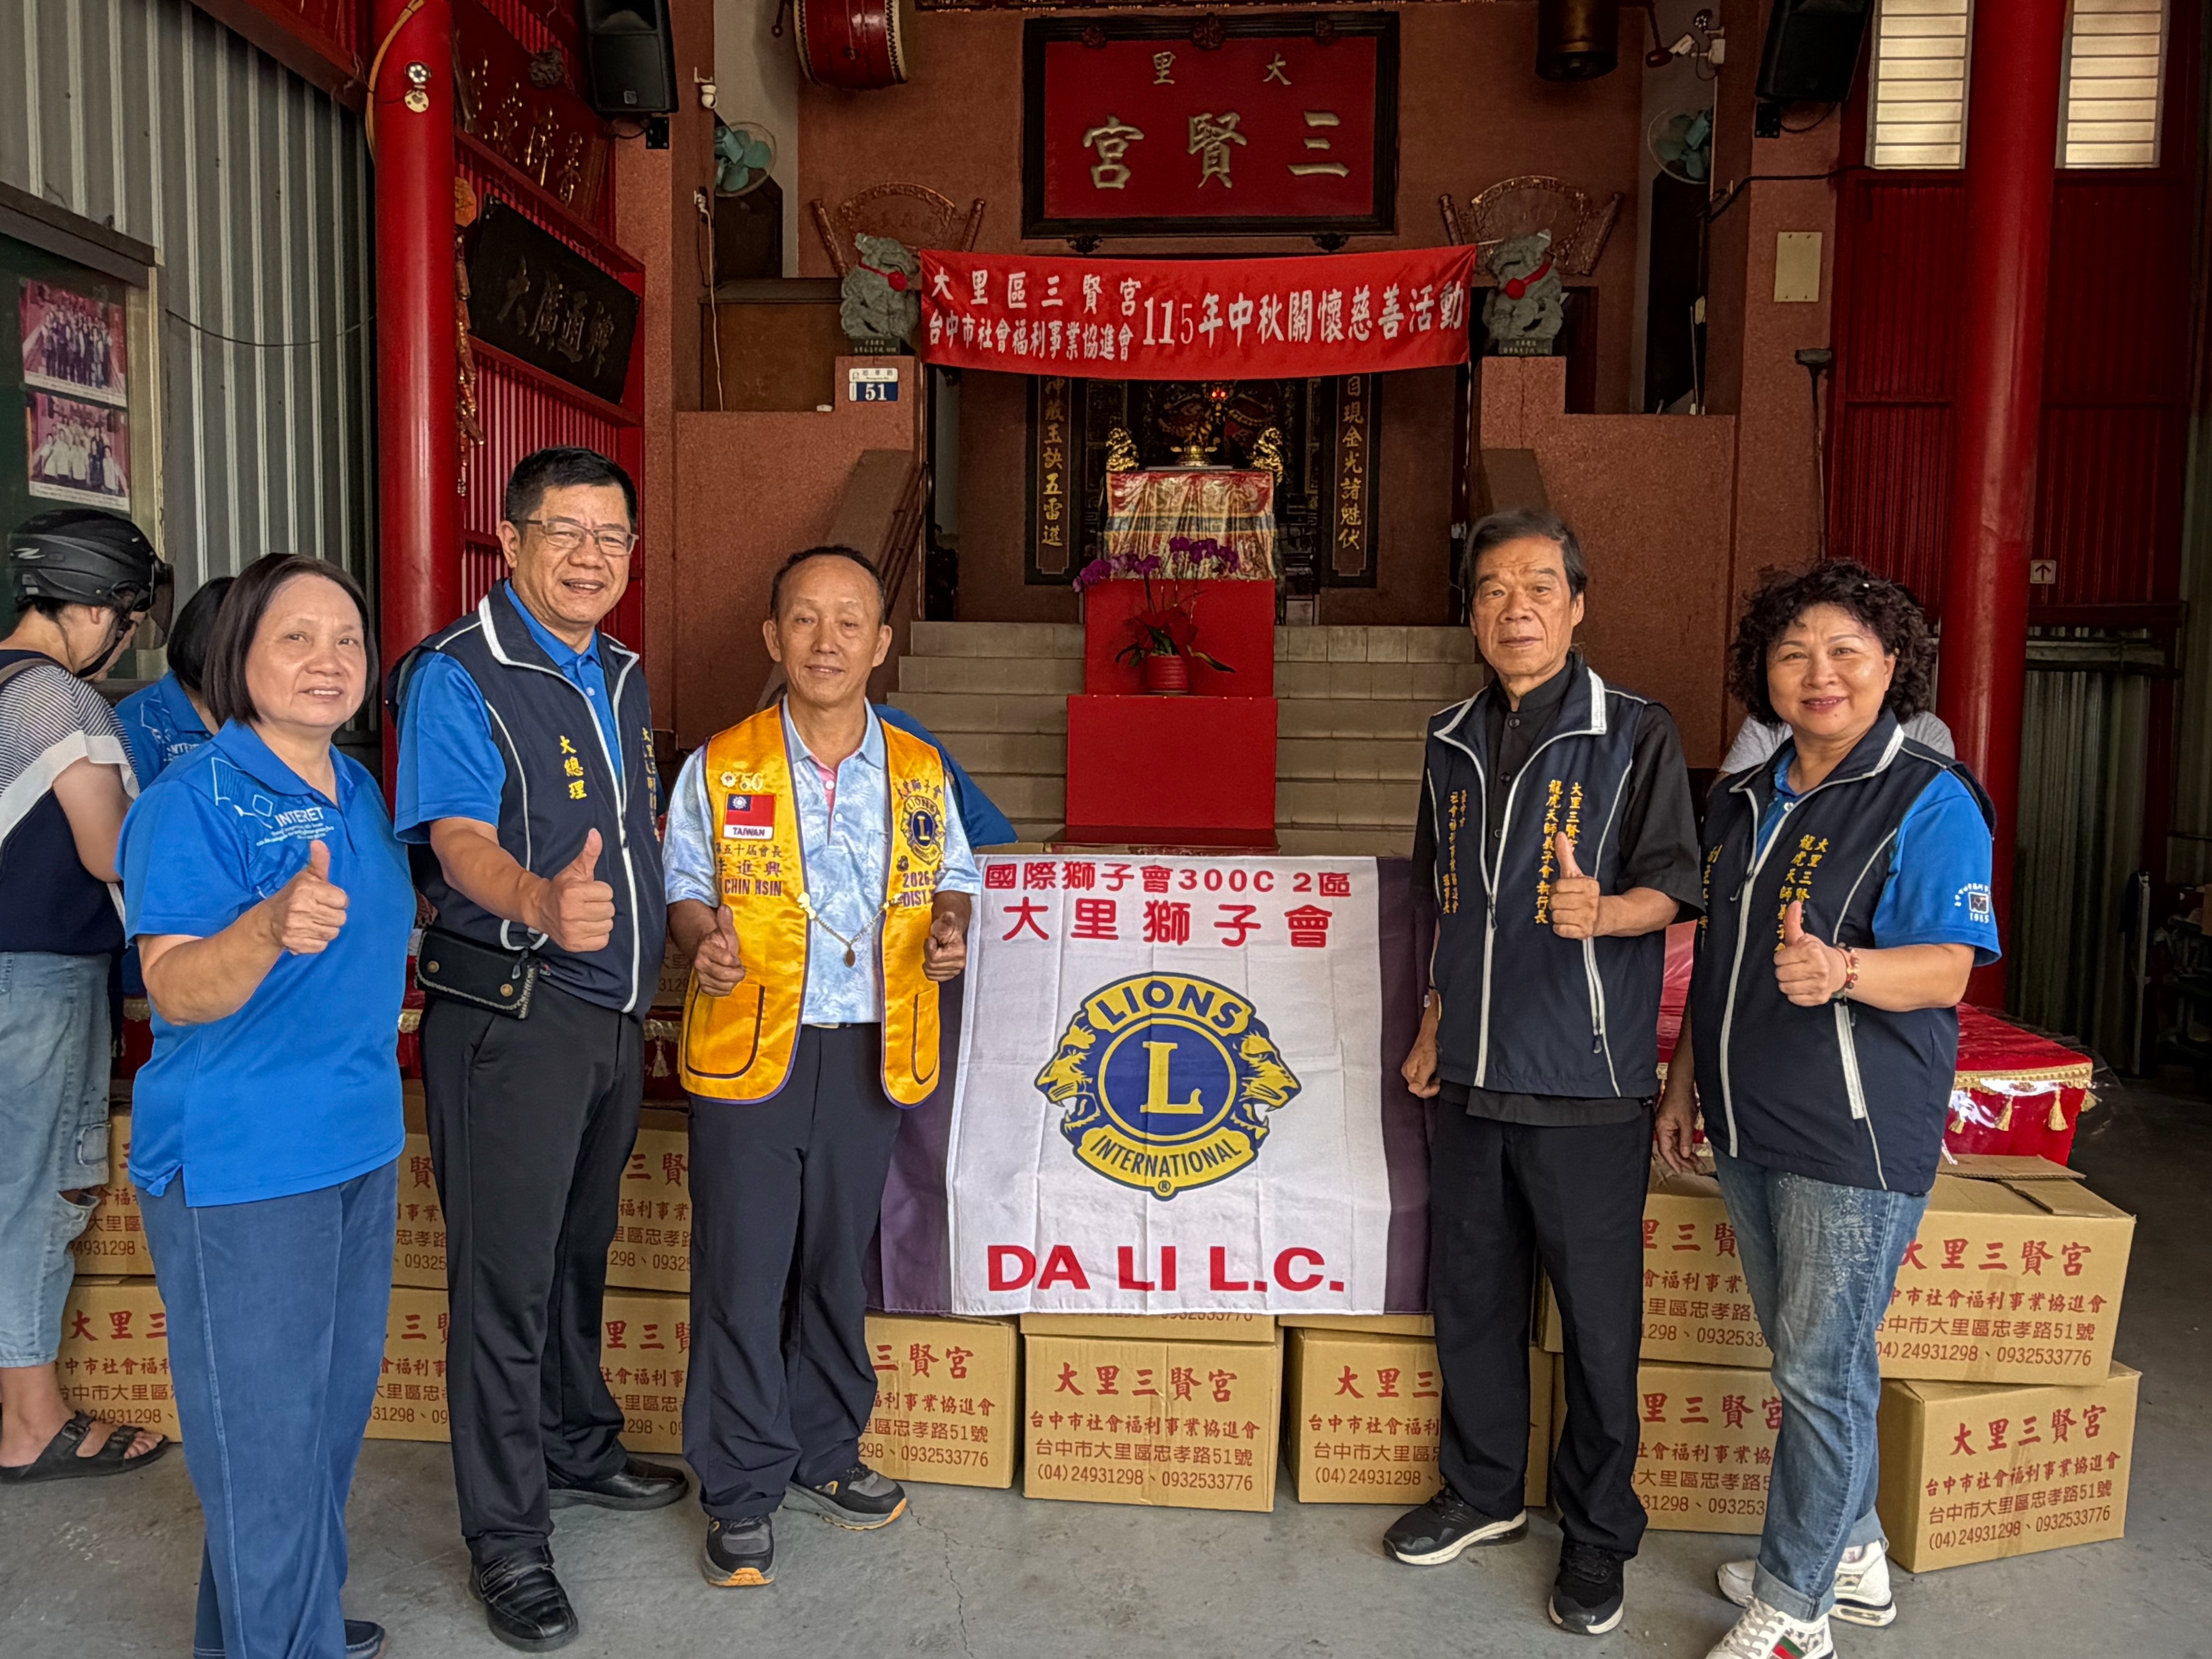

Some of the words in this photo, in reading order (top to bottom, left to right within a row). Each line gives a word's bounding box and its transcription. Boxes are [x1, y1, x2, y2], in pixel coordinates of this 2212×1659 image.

[1083, 110, 1350, 189] 三賢宮
[931, 266, 1142, 317] 大里區三賢宮
[929, 309, 1134, 362] 台中市社會福利事業協進會
[865, 384, 887, 401] 51
[560, 735, 587, 800] 大總理
[733, 826, 765, 836] TAIWAN
[725, 879, 750, 895] CHIN
[755, 879, 782, 896] HSIN
[984, 862, 1274, 894] 國際獅子會300C
[1292, 871, 1352, 898] 2區
[1002, 896, 1333, 948] 大里獅子會
[1096, 980, 1244, 1032] LIONS
[1140, 1041, 1204, 1115] L
[626, 1152, 687, 1187] 三賢
[1089, 1134, 1242, 1178] INTERNATIONAL
[620, 1199, 689, 1221] 福利事業
[988, 1245, 1091, 1291] DA
[1117, 1245, 1176, 1291] LI
[1209, 1245, 1345, 1293] L.C.
[1899, 1238, 2092, 1276] 大里三賢宮
[69, 1309, 167, 1341] 大里三
[873, 1343, 974, 1379] 三賢宮
[1054, 1362, 1237, 1403] 大里三賢宮
[1334, 1365, 1439, 1399] 大里三
[1030, 1410, 1261, 1440] 台中市社會福利事業協進會
[1309, 1413, 1440, 1436] 台中市社會福利
[1642, 1393, 1782, 1429] 里三賢宮
[1949, 1404, 2107, 1456] 大里三賢宮
[1035, 1438, 1253, 1467] 台中市大里區忠孝路51號
[1632, 1468, 1771, 1491] 大里區忠孝路5
[1925, 1451, 2121, 1497] 台中市社會福利事業協進會
[1928, 1480, 2112, 1525] 台中市大里區忠孝路51號
